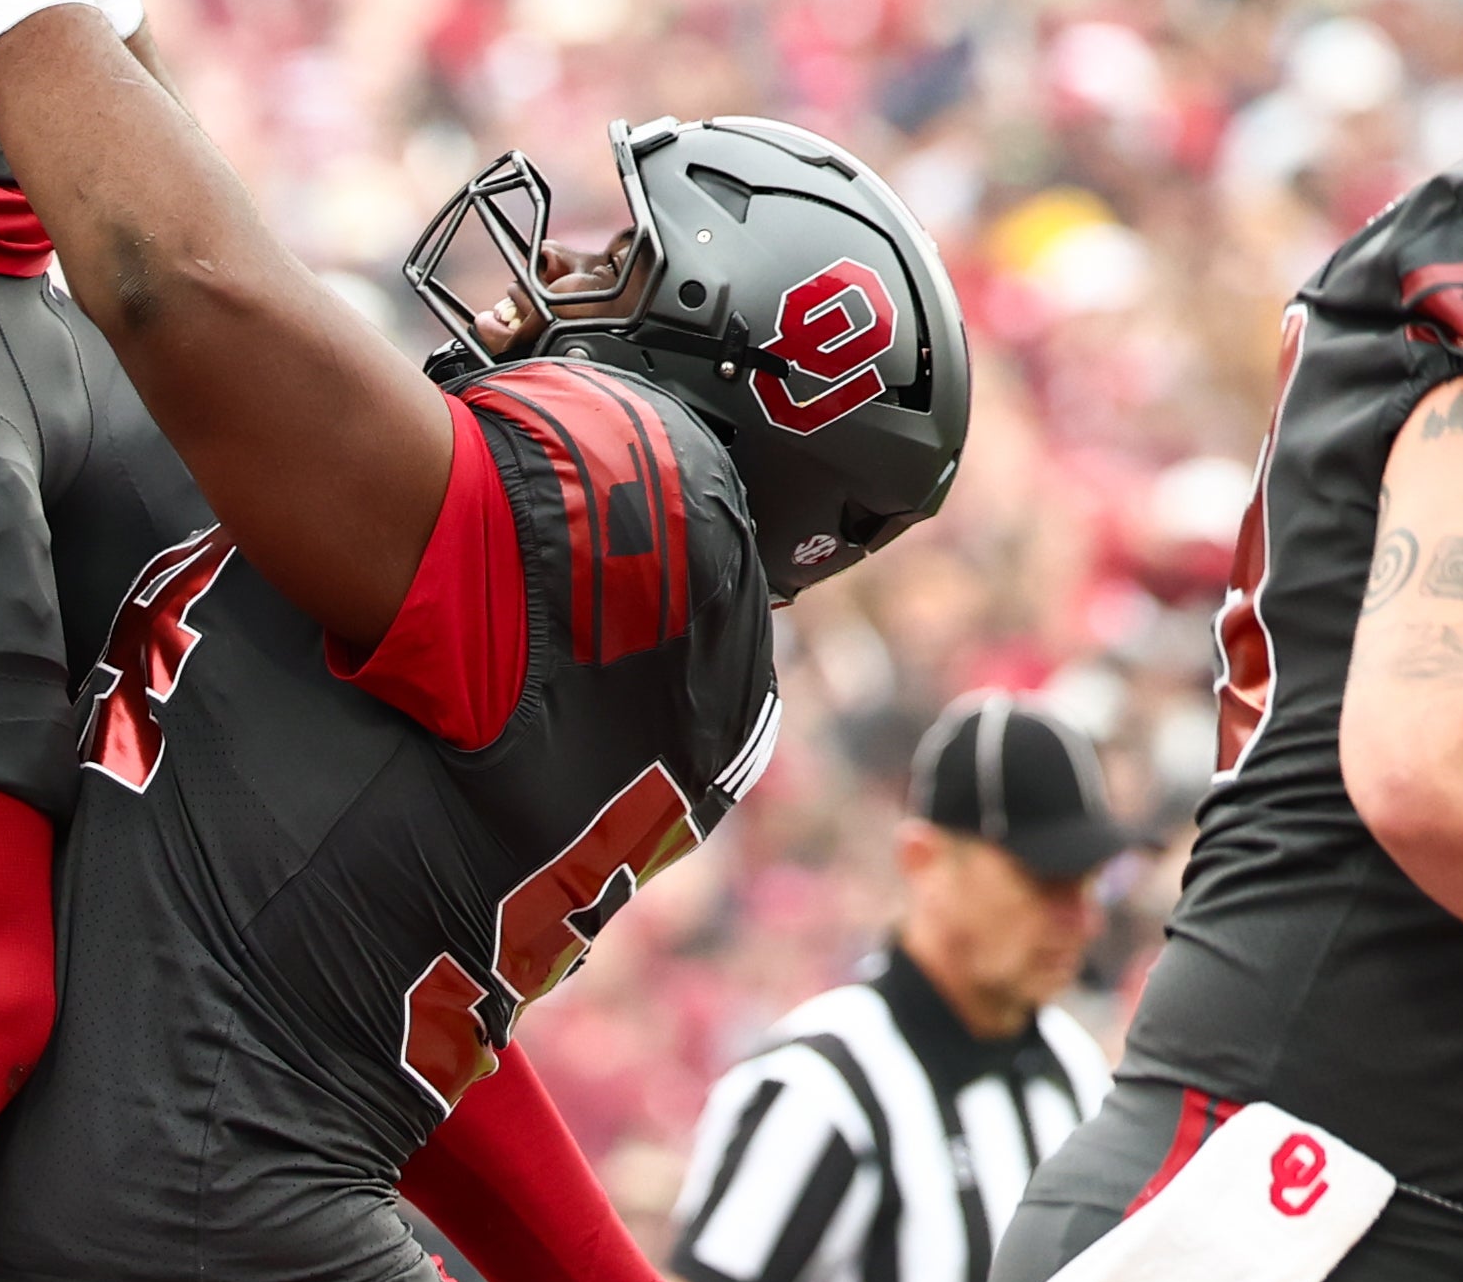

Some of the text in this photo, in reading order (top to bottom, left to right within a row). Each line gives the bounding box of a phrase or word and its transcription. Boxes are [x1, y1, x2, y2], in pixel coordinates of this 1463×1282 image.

[748, 256, 899, 436] OU
[75, 522, 237, 795] 4
[1269, 1132, 1329, 1217] OU
